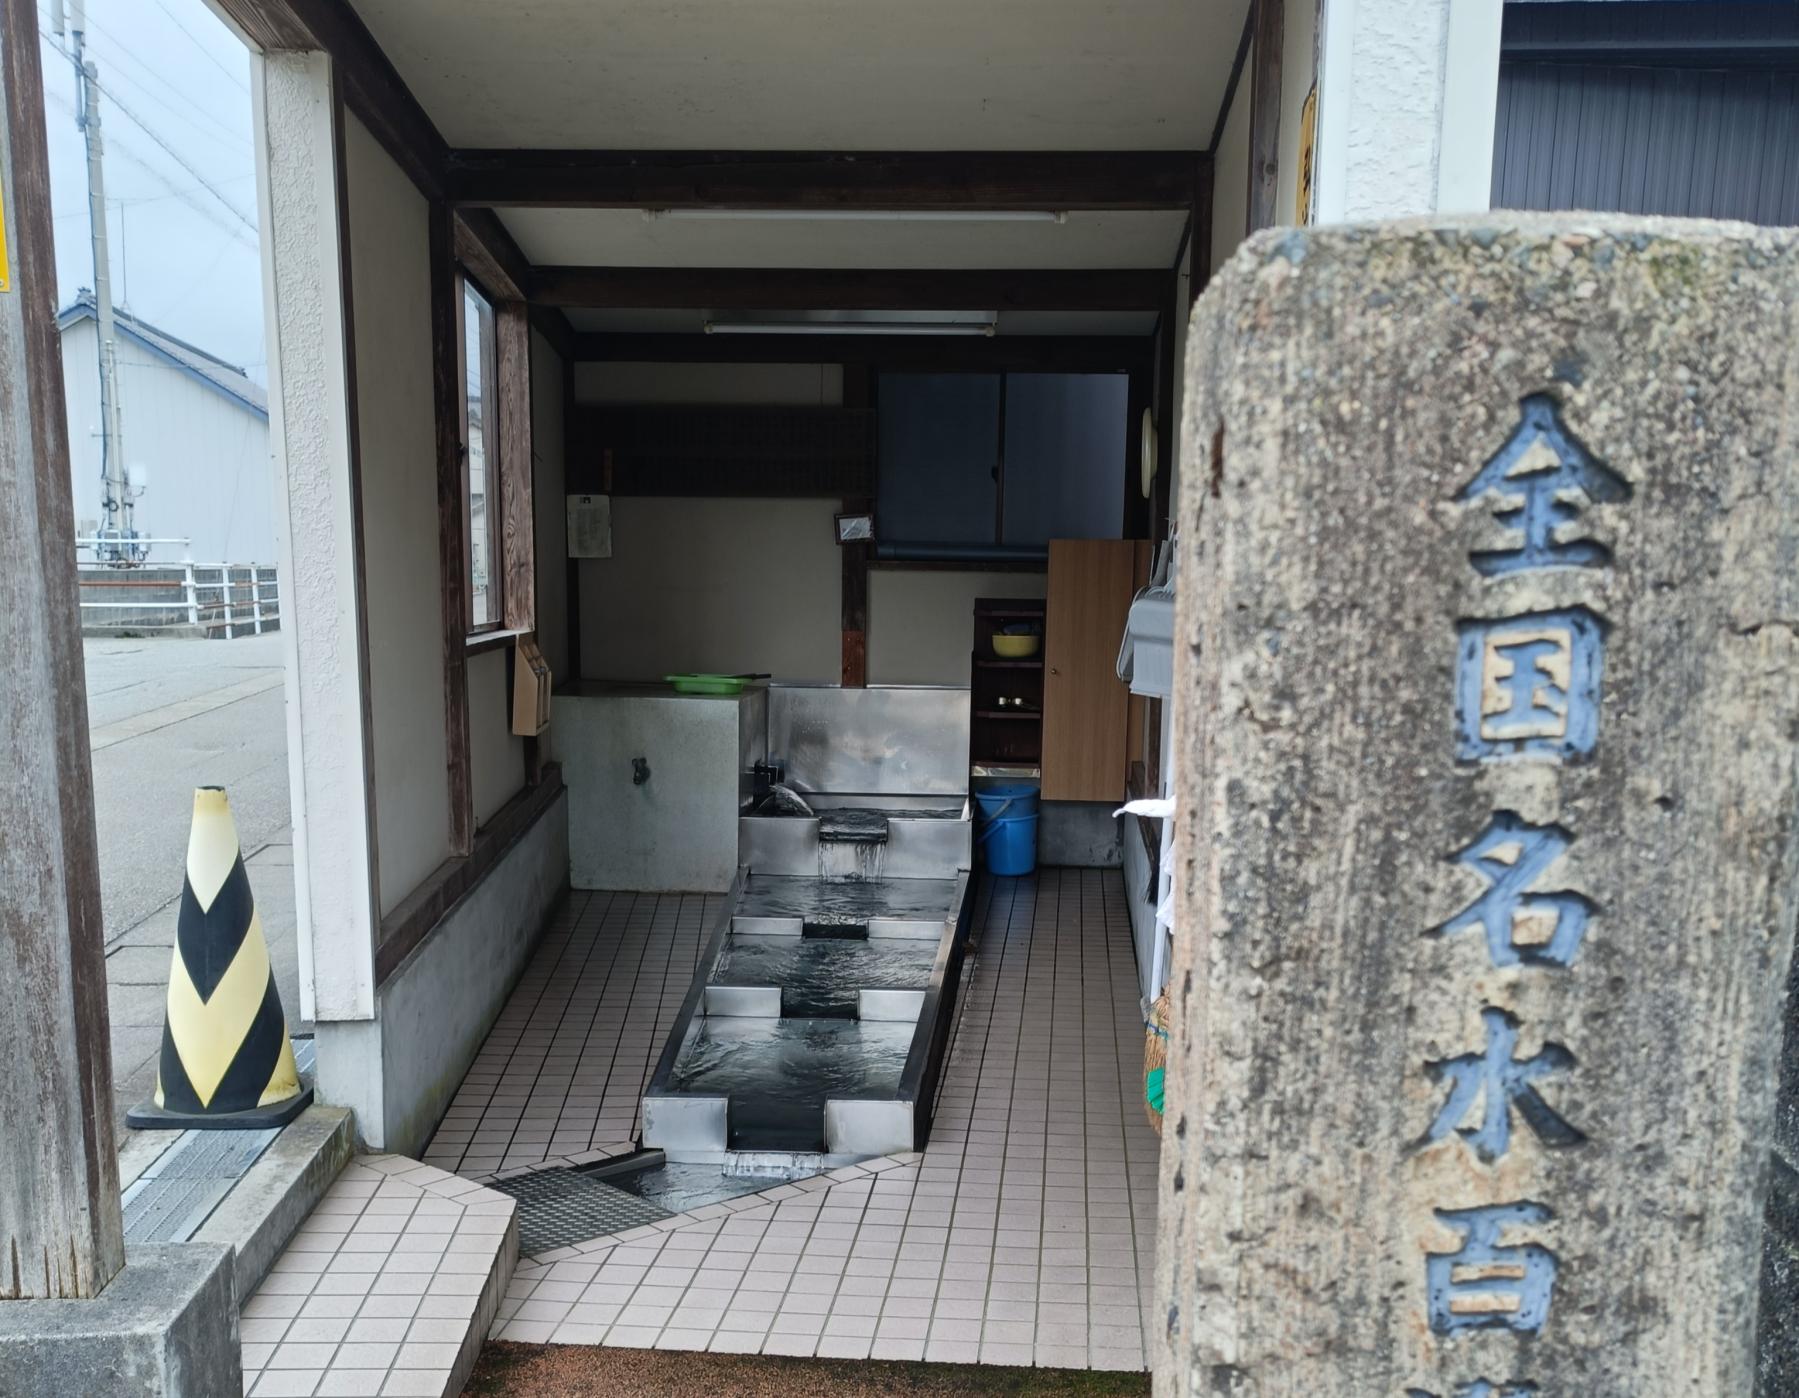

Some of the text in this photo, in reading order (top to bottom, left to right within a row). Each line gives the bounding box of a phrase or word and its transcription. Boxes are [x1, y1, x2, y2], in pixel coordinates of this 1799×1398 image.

[1403, 391, 1634, 1398] 全国名水百
